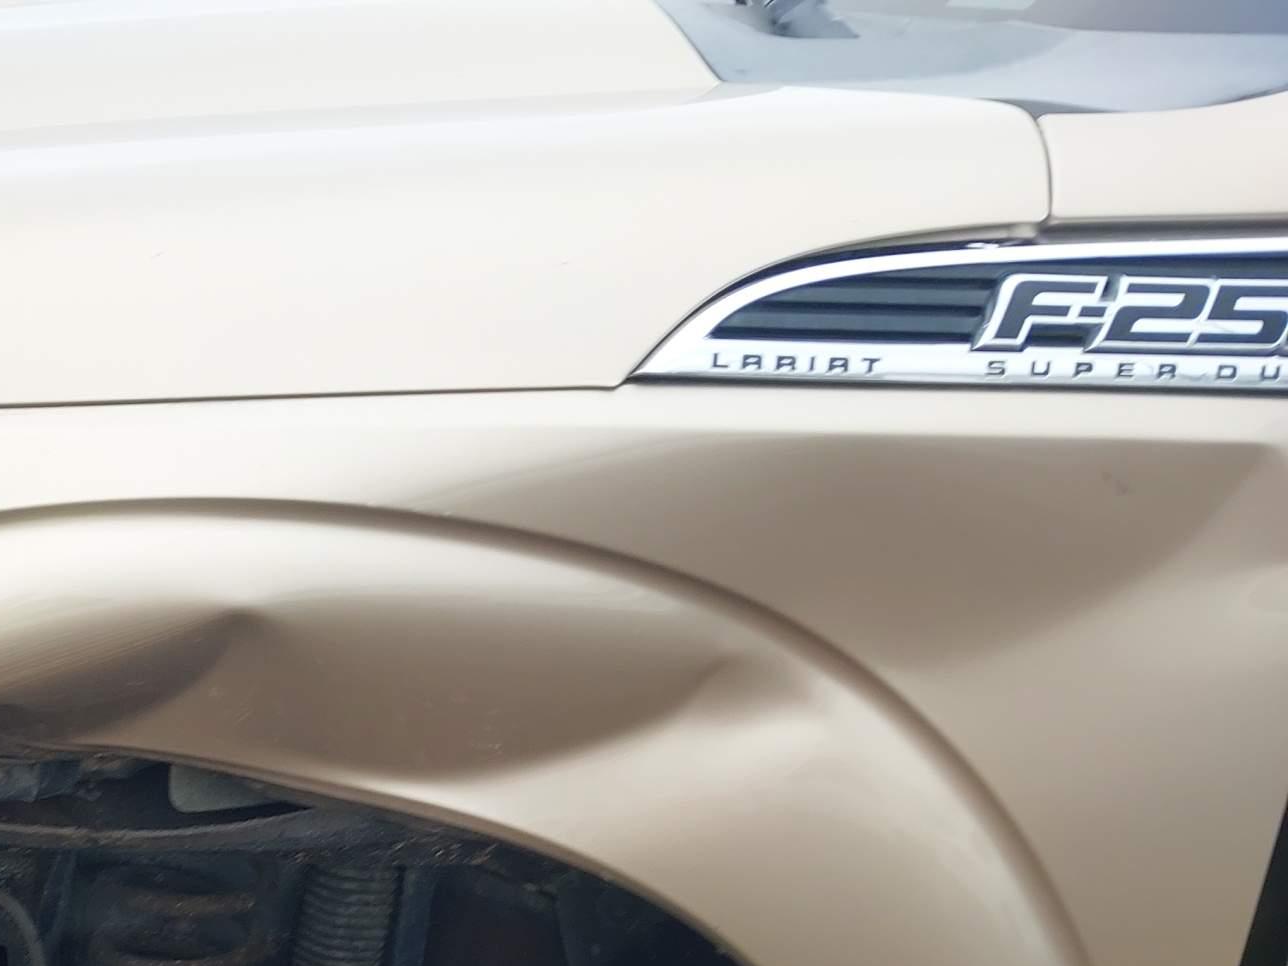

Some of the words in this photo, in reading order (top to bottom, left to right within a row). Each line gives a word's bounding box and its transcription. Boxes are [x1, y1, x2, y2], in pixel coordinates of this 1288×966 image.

[711, 353, 881, 374] LARIAT
[985, 361, 1177, 379] SUPER
[1215, 364, 1282, 380] DU
